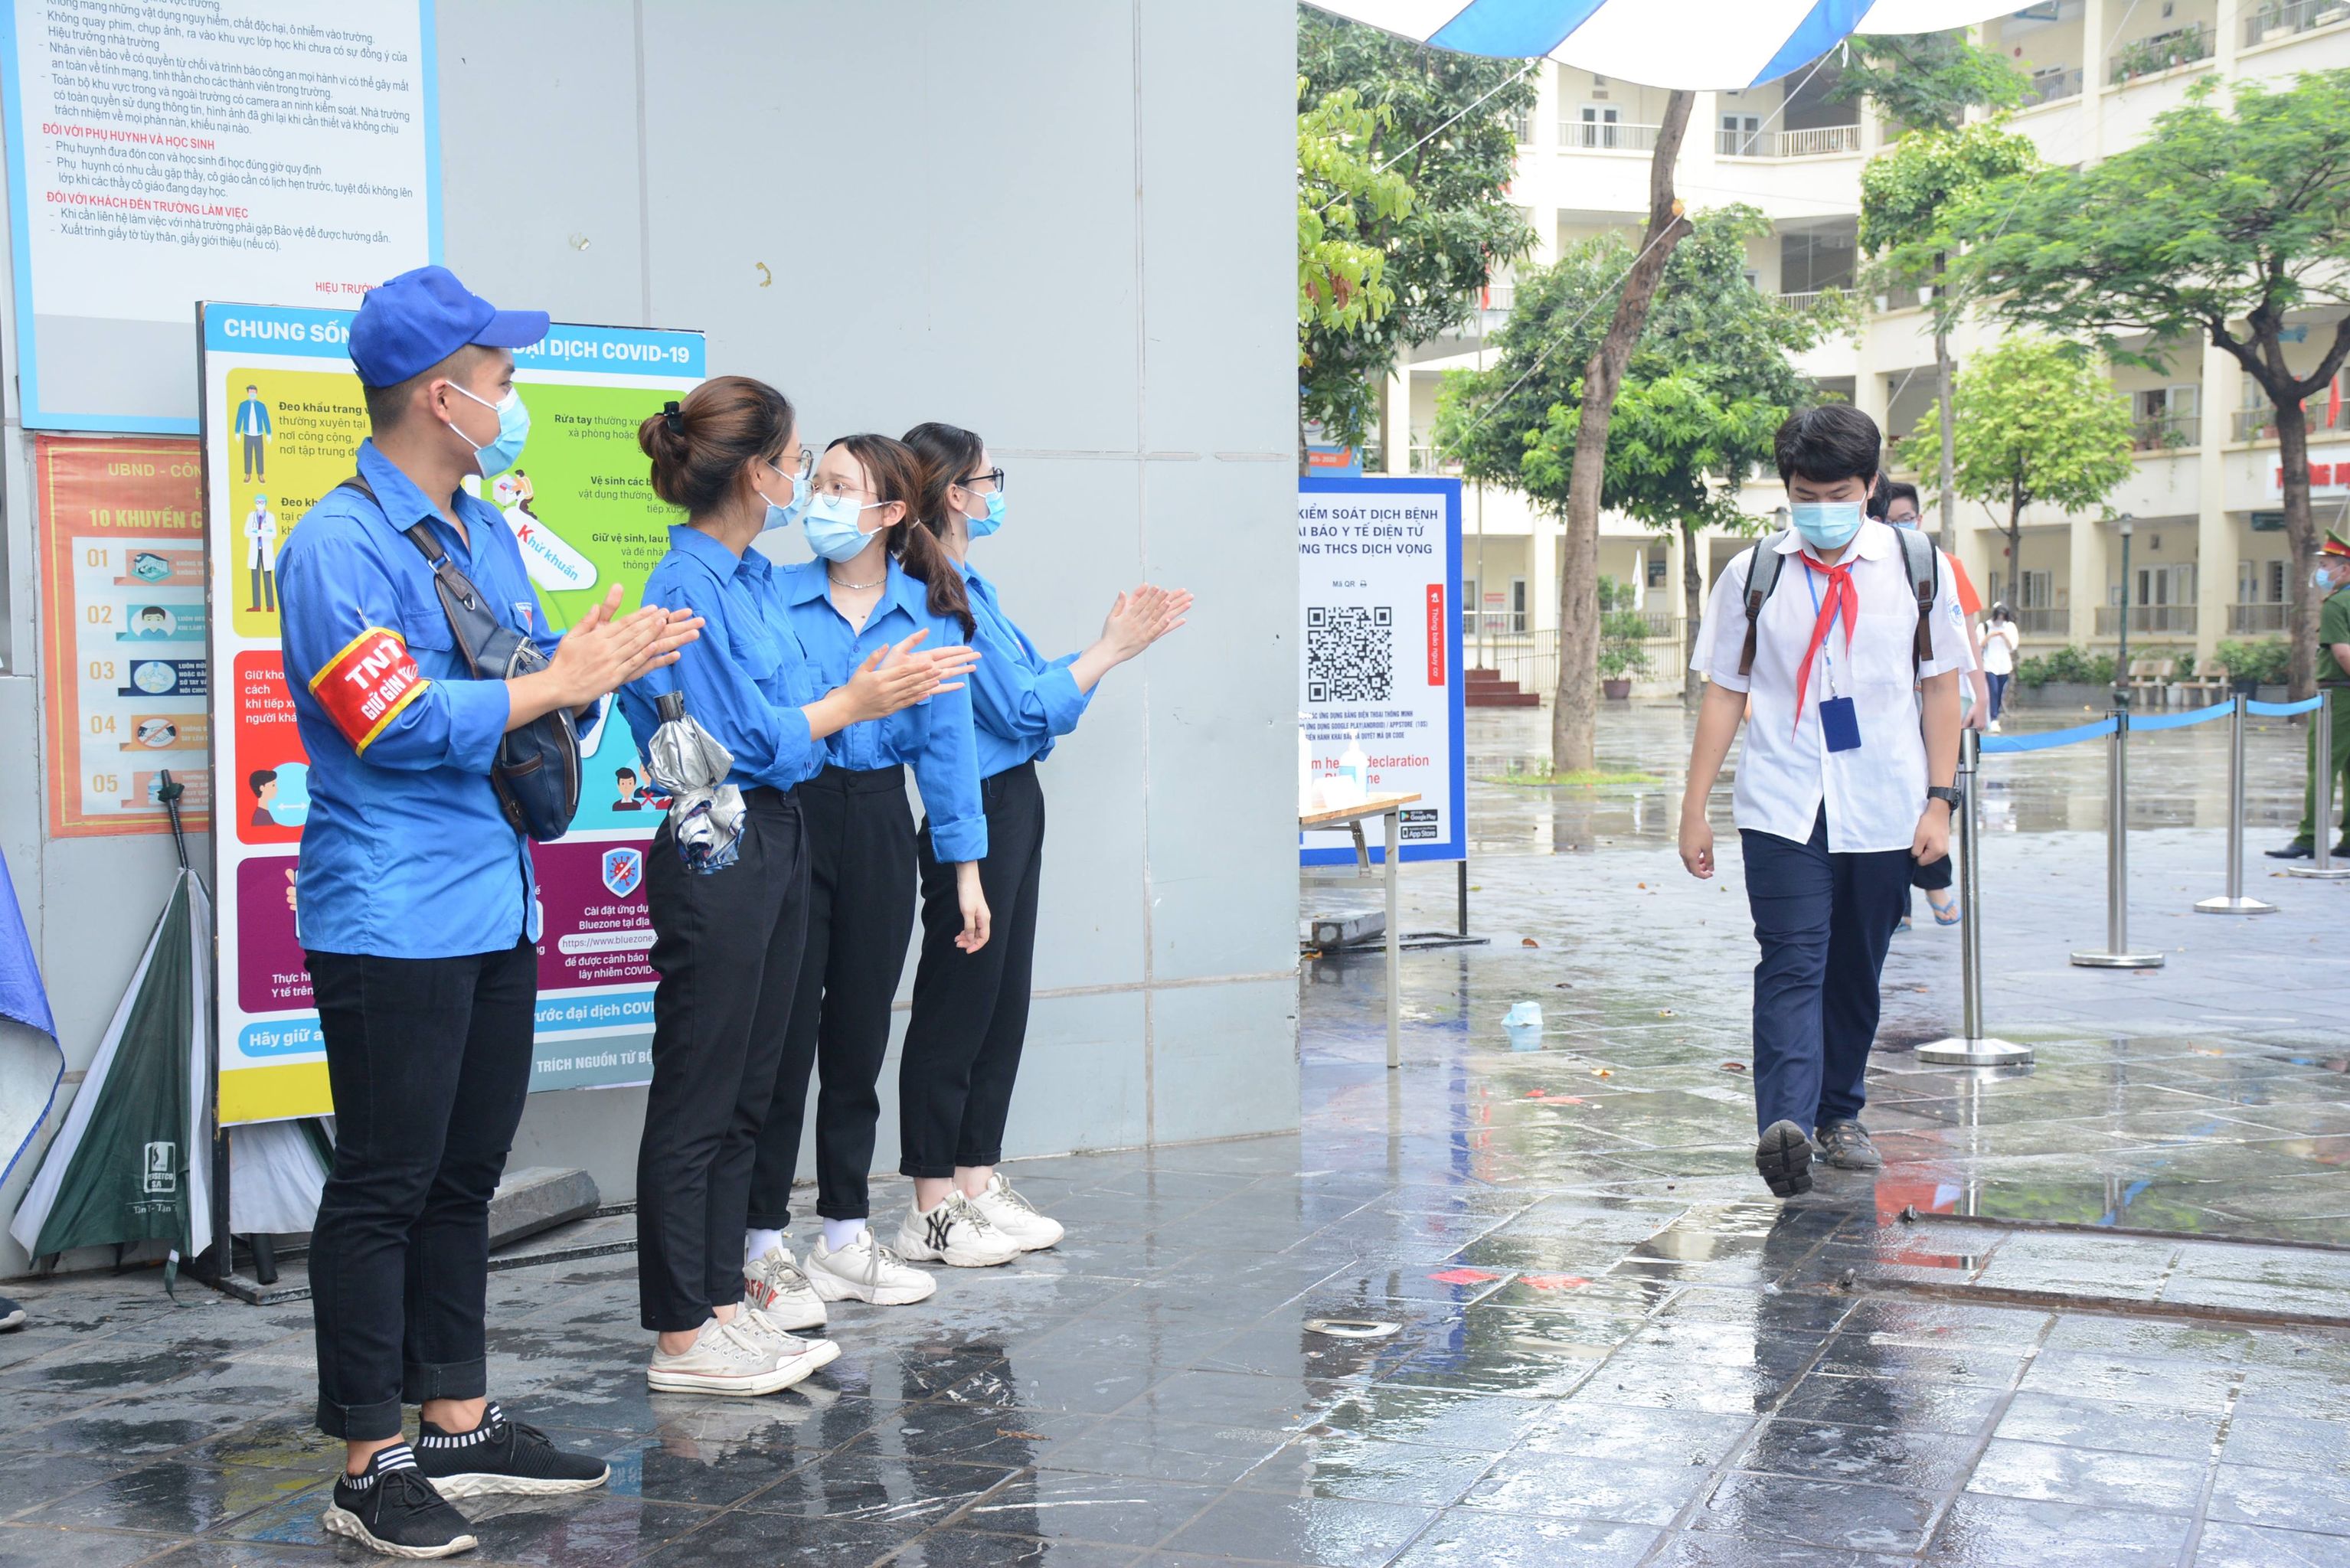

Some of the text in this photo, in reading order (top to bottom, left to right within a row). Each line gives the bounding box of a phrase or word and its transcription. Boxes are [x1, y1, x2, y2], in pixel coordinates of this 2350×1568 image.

[47, 11, 407, 63] Không quay phim, chụp ảnh, ra vào khu vực lớp học khi chưa có sự đồng ý của
[64, 124, 83, 136] VỚI
[86, 128, 107, 142] PHỤ
[110, 131, 147, 143] HUYNH
[149, 132, 163, 145] VÀ
[165, 136, 188, 150] HỌC
[191, 139, 214, 150] SINH
[69, 191, 87, 204] VỚI
[90, 194, 127, 208] KHÁCH
[152, 200, 199, 214] TRƯỜNG
[201, 203, 224, 216] LÀM
[226, 207, 248, 218] VIỆC
[224, 318, 306, 341] CHUNG
[550, 339, 598, 361] DỊCH
[602, 341, 690, 364] COVID-19
[279, 401, 300, 411] Đeo
[303, 401, 330, 413] khẩu
[332, 404, 362, 416] trang
[279, 416, 366, 430] thường xuyên tại
[554, 414, 628, 428] Rửa tay thường
[279, 431, 354, 444] nơi công cộng,
[568, 429, 635, 441] xà phòng hoặc
[279, 446, 296, 454] nơi
[299, 445, 315, 457] tập
[318, 446, 345, 459] trung
[108, 462, 155, 477] UBND
[590, 475, 603, 487] Vệ
[605, 476, 626, 486] sinh
[627, 476, 644, 486] các
[281, 497, 302, 507] Đeo
[578, 489, 652, 501] vật dụng thường
[89, 508, 110, 527] 10
[116, 505, 186, 529] KHUYẾN
[647, 505, 665, 514] tiếp
[1332, 506, 1366, 520] SOÁT
[1371, 509, 1401, 522] DỊCH
[1405, 506, 1438, 523] BỆNH
[592, 533, 664, 544] Giữ vệ sinh, lau
[1311, 522, 1424, 540] BÁO Y TẾ ĐIỆN TỬ
[87, 548, 108, 567] 01
[517, 524, 579, 581] Khử khuẩn
[621, 548, 632, 557] và
[646, 548, 665, 557] nhà
[1325, 544, 1358, 554] THCS
[1362, 544, 1392, 557] DỊCH
[1396, 544, 1433, 557] VỌNG
[623, 559, 650, 571] thông
[87, 606, 112, 624] 02
[90, 661, 115, 680] 03
[345, 639, 403, 690] TNT
[245, 670, 263, 680] Giữ
[245, 684, 270, 694] cách
[245, 698, 261, 709] khi
[264, 697, 284, 710] tiếp
[361, 674, 407, 720] GIỮ GÌN
[90, 715, 116, 734] 04
[246, 712, 276, 725] người
[93, 774, 118, 792] 05
[584, 906, 599, 916] Cài
[600, 906, 616, 917] đặt
[617, 904, 635, 915] ứng
[579, 917, 650, 930] Bluezone tại địa
[565, 952, 643, 969] để được cảnh báo
[272, 972, 299, 985] Thực
[579, 969, 592, 982] lây
[594, 967, 623, 978] nhiễm
[272, 985, 314, 998] Y tế trên
[566, 1005, 588, 1022] đại
[590, 1004, 620, 1021] dịch
[250, 1027, 311, 1048] Hãy giữ
[537, 1057, 572, 1073] TRÍCH
[575, 1050, 617, 1070] NGUỒN
[620, 1051, 636, 1065] TỪ
